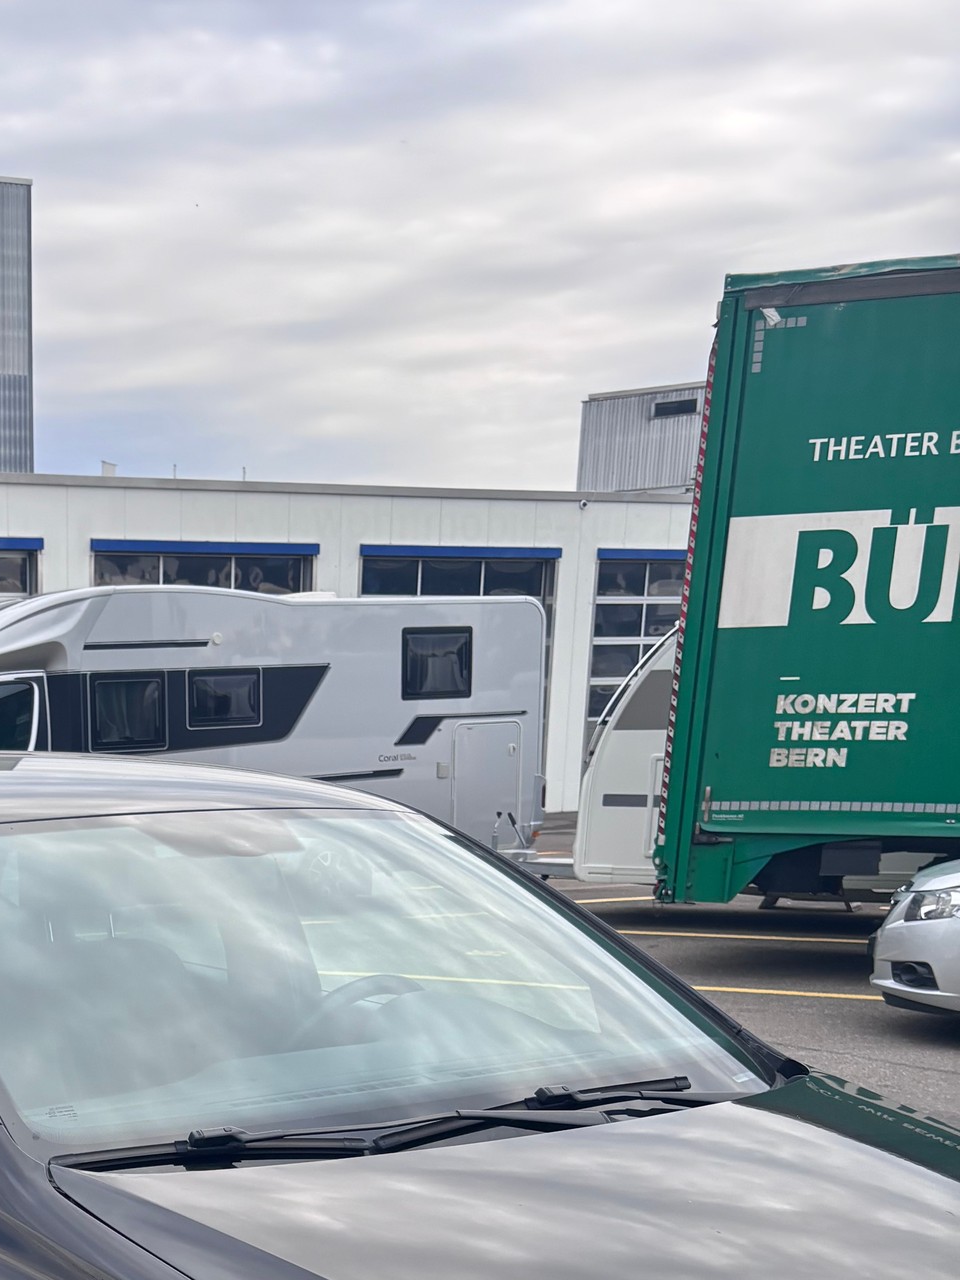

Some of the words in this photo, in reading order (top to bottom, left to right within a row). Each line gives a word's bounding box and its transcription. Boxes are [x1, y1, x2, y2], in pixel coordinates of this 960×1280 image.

[808, 431, 939, 462] THEATER
[787, 507, 960, 626] BÜ
[775, 693, 916, 714] KONZERT
[774, 720, 908, 741] THEATER
[769, 748, 848, 767] BERN
